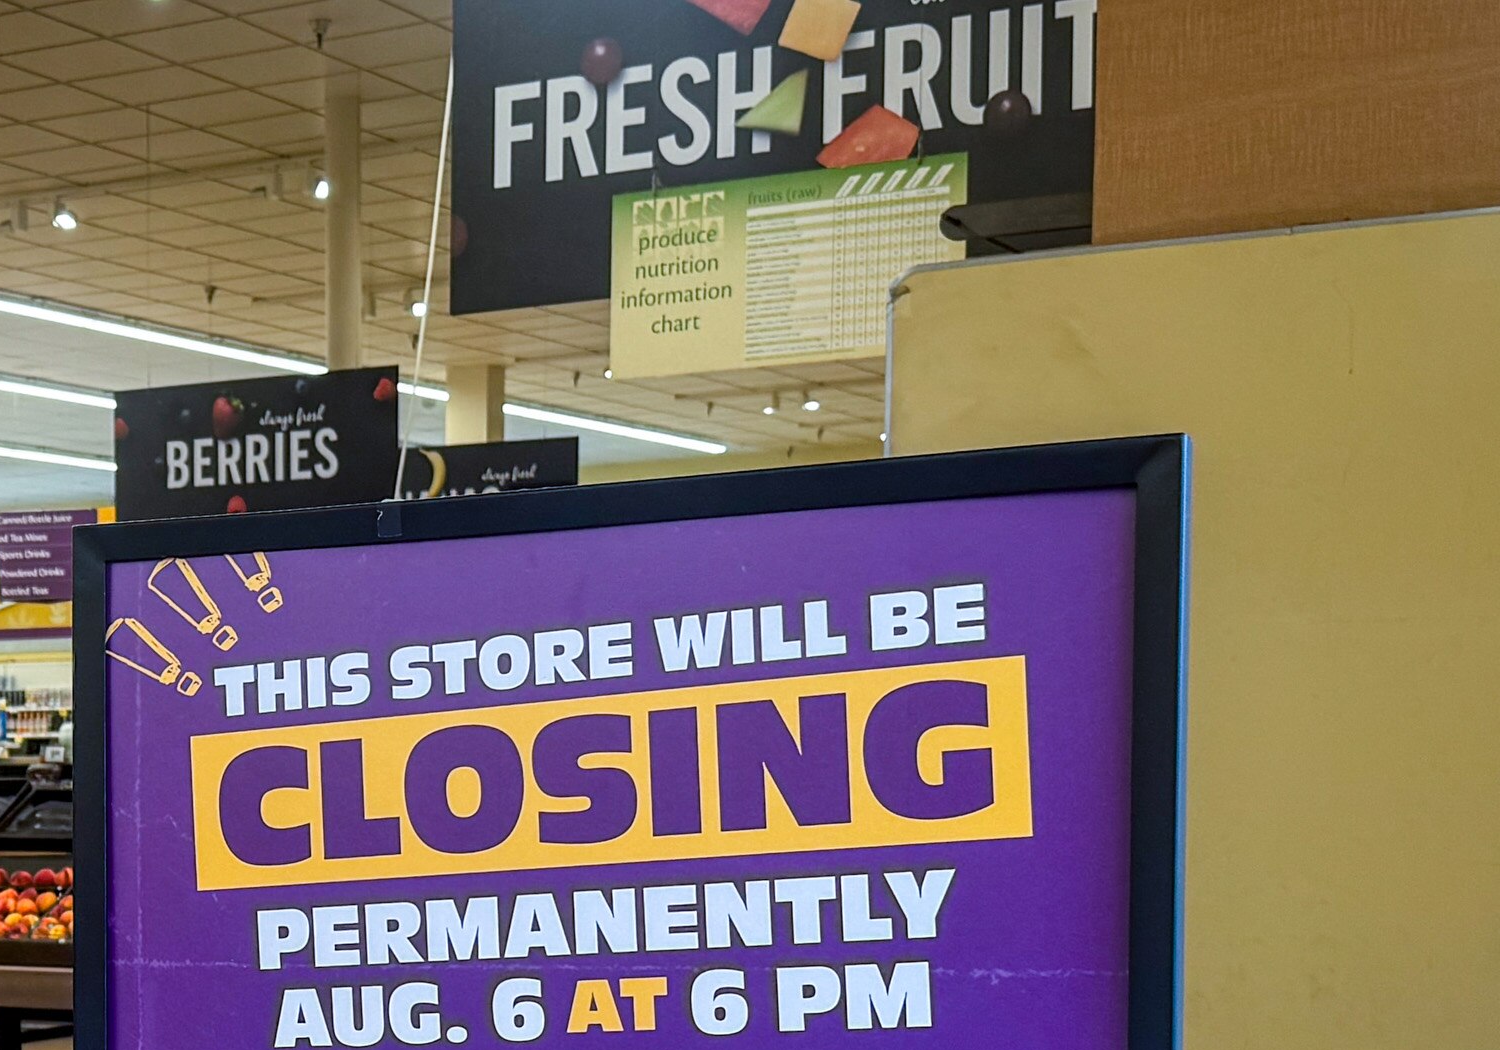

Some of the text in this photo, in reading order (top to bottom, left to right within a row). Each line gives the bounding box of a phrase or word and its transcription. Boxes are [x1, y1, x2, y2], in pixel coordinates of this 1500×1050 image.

[493, 0, 1098, 189] FRESH FRUIT
[747, 190, 783, 205] fruits
[786, 184, 823, 203] (raw)
[635, 255, 719, 280] nutrition
[638, 224, 719, 254] produce
[621, 282, 732, 309] information
[650, 315, 701, 335] chart
[166, 426, 340, 490] BERRIES
[214, 584, 985, 716] THIS STORE WILL BE
[219, 680, 994, 866] CLOSING
[257, 869, 955, 970] PERMANENTLY
[274, 962, 932, 1047] AUG. 6 AT 6 PM
